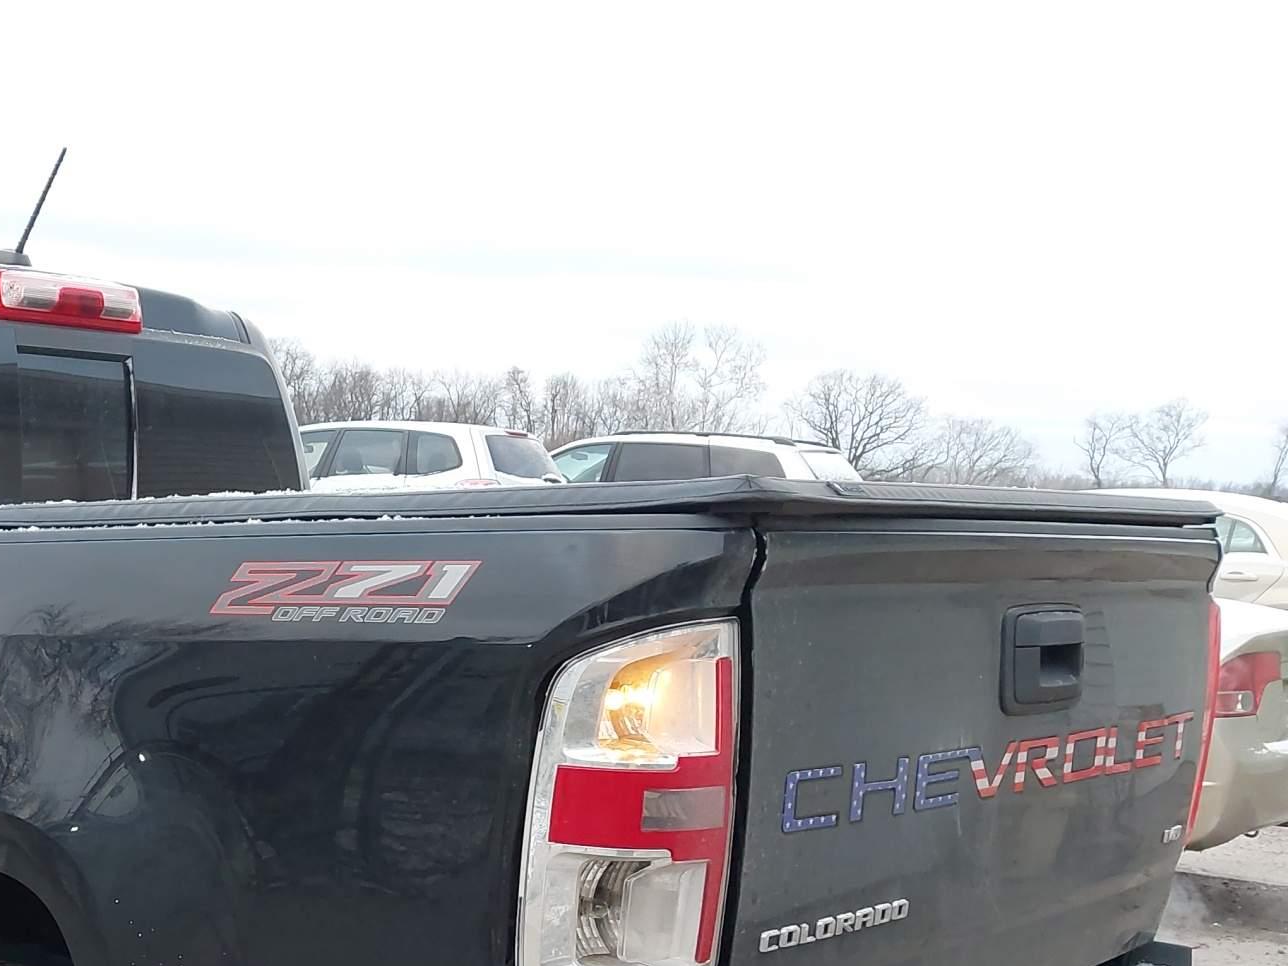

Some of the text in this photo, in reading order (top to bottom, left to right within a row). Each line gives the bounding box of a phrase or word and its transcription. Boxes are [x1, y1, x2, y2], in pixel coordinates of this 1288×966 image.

[210, 560, 482, 614] Z71
[272, 606, 446, 624] OFF ROAD
[781, 711, 1194, 833] CHEVROLET
[760, 899, 909, 952] COLORADO
